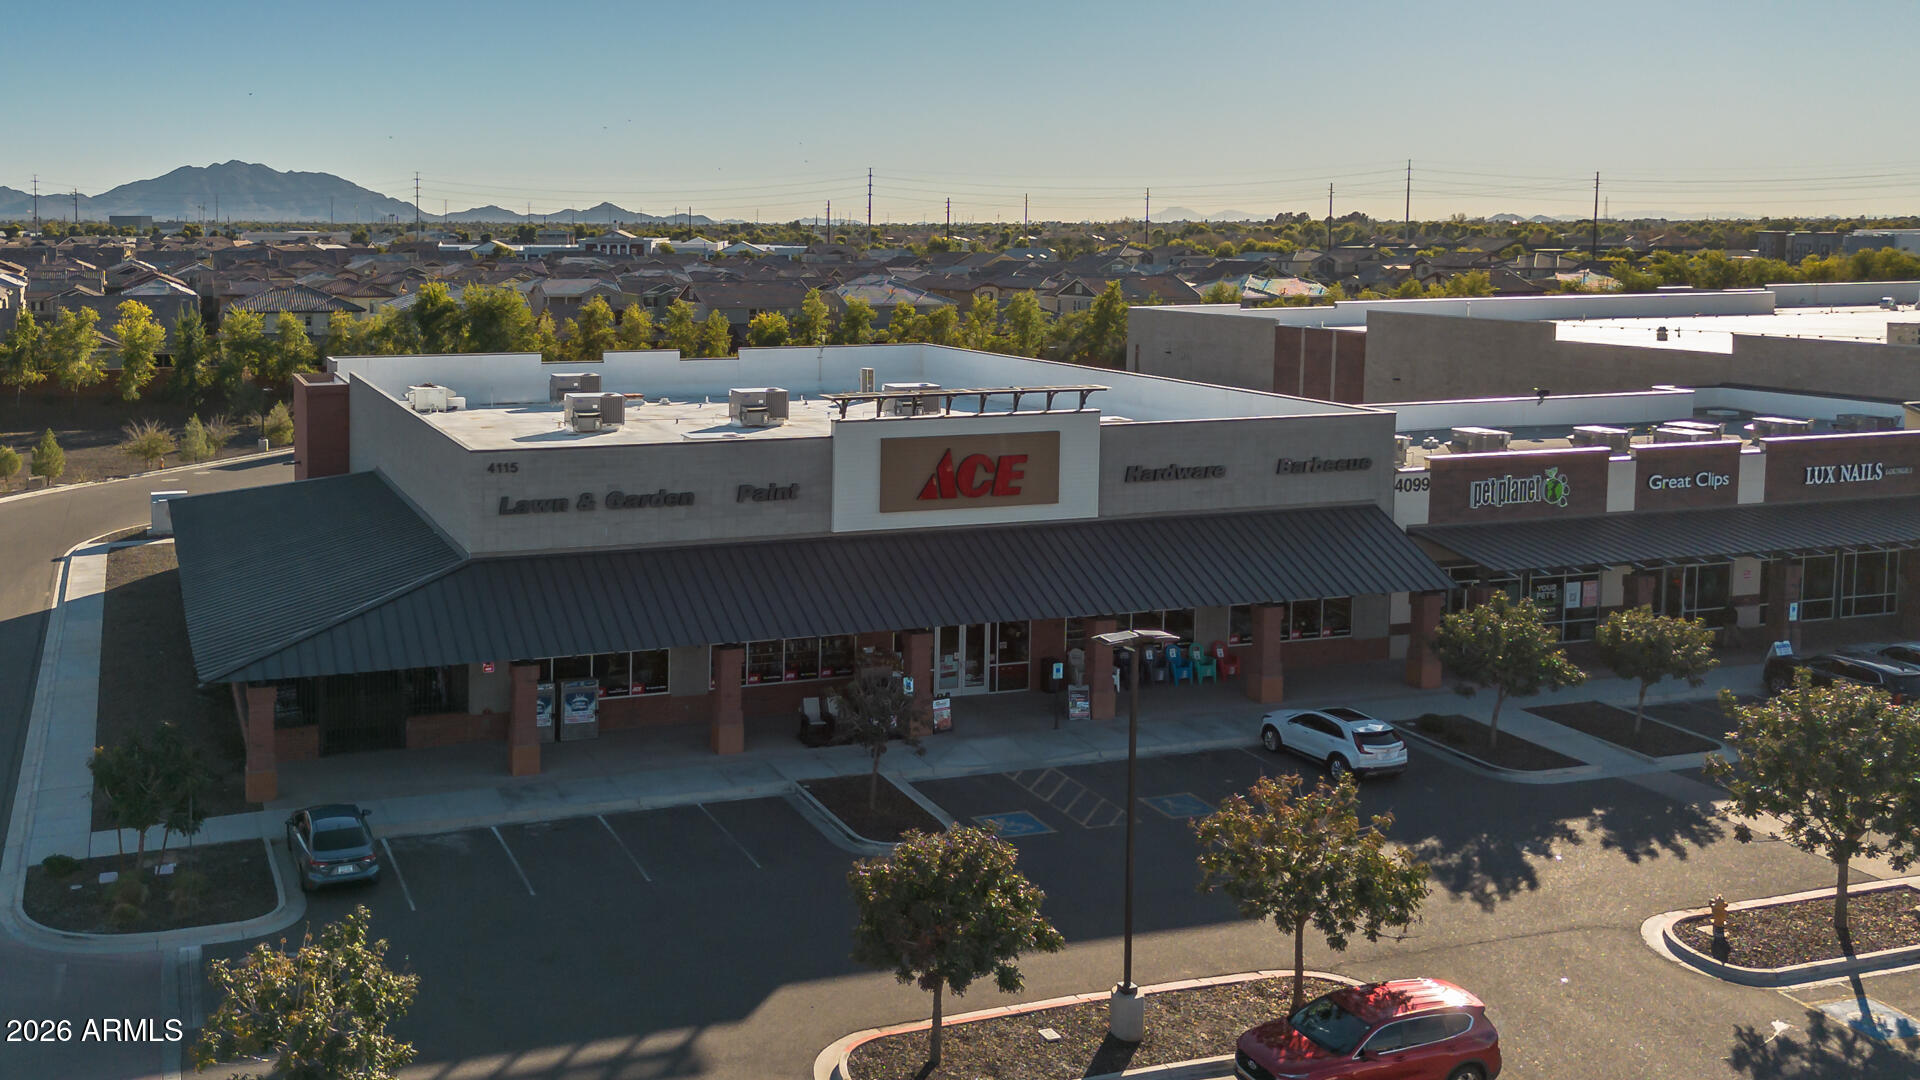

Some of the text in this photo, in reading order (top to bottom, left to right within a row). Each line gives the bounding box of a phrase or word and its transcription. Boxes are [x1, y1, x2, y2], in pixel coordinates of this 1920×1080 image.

[487, 462, 519, 474] 4115
[917, 448, 1029, 500] ACE
[1124, 463, 1226, 483] Hardware
[1805, 466, 1837, 485] LUX
[1840, 462, 1884, 483] NAILS
[1395, 475, 1430, 492] 4099
[1649, 471, 1730, 491] Great Clips
[737, 483, 800, 503] Paint
[1470, 475, 1542, 508] pet planet
[499, 489, 695, 515] Lawn & Garden
